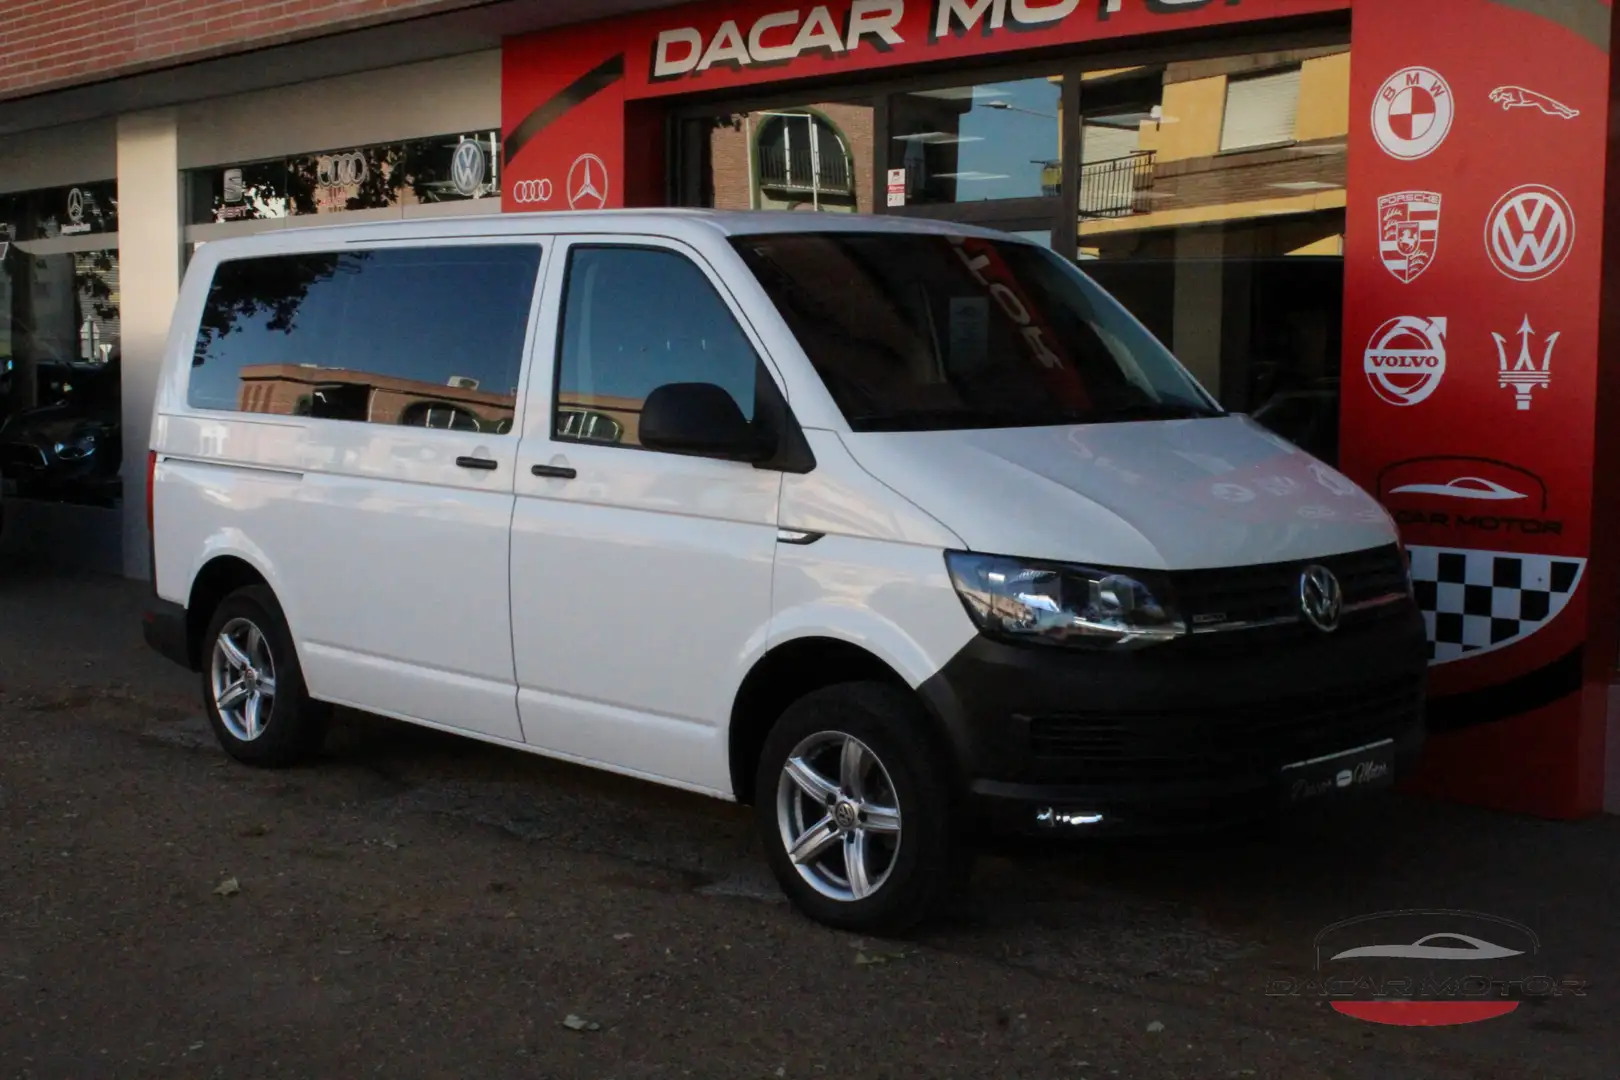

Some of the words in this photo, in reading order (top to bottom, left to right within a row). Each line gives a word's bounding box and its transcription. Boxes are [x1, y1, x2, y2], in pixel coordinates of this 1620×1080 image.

[654, 1, 905, 77] DACAR
[1382, 72, 1446, 102] BMW
[1381, 193, 1440, 207] PORSCHE
[1370, 355, 1440, 368] VOLVO
[1455, 513, 1563, 536] MOTOR
